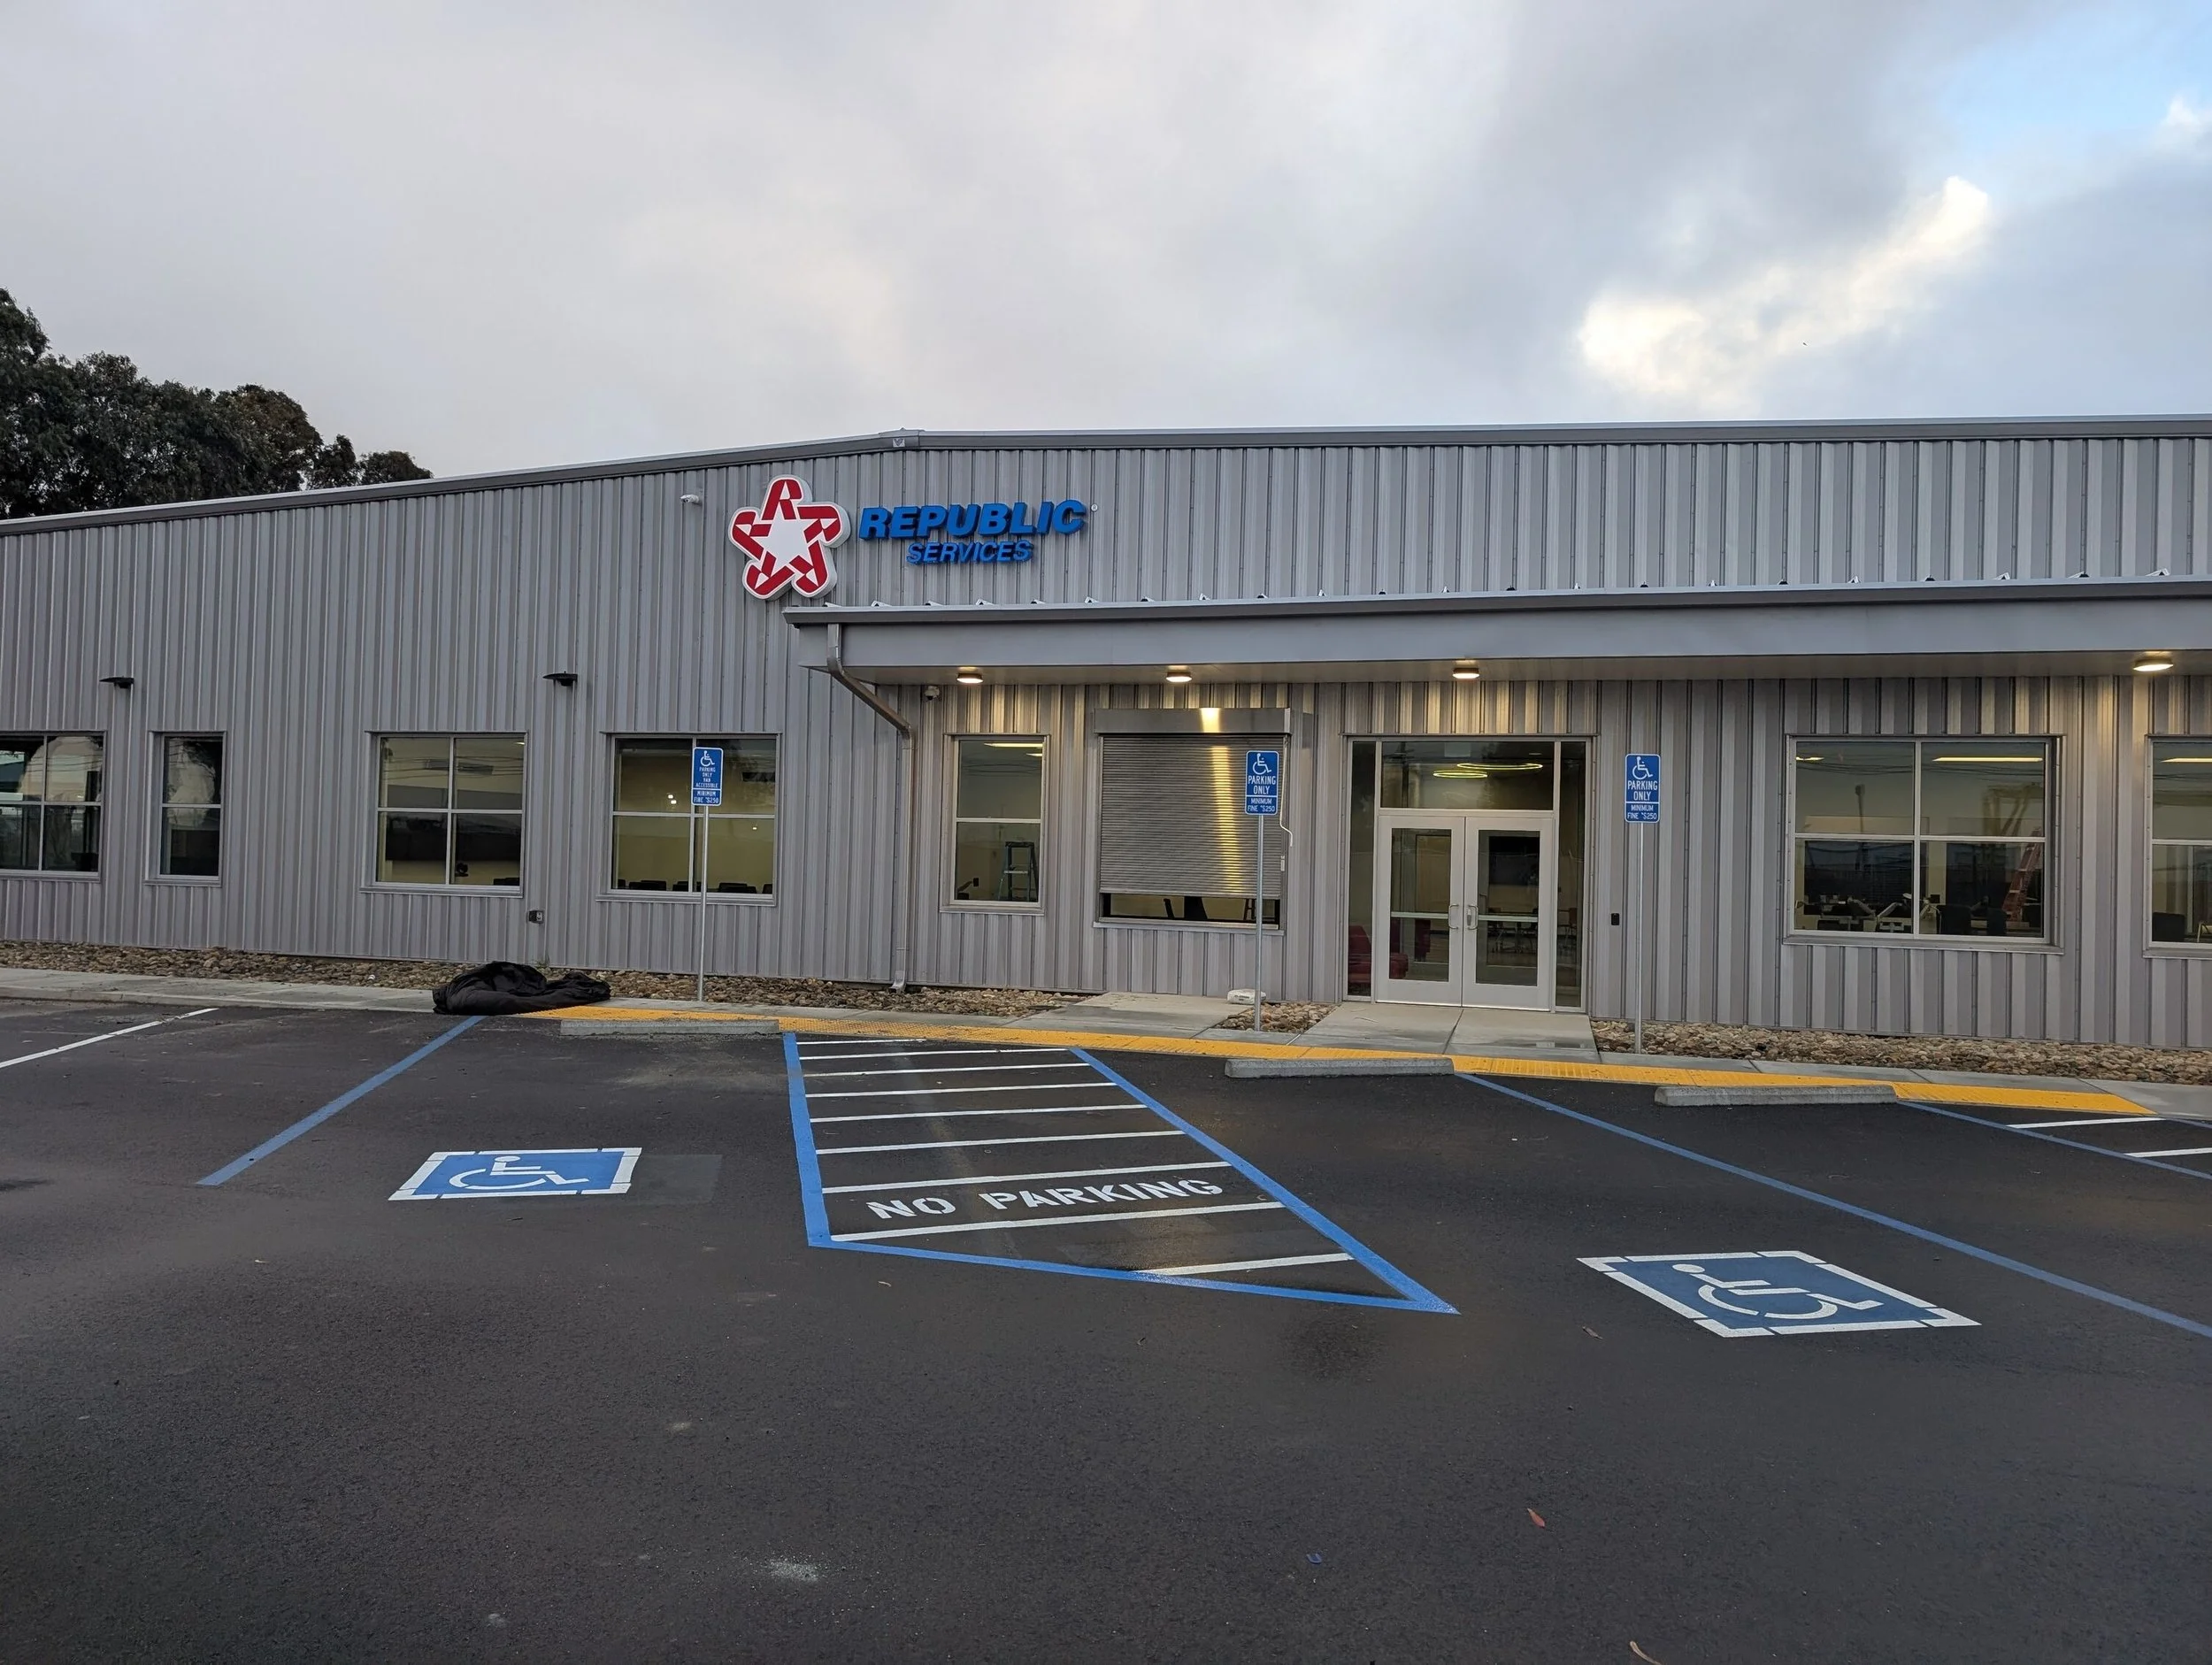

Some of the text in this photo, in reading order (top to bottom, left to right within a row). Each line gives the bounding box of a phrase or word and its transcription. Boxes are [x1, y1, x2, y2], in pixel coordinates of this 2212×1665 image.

[858, 500, 1087, 540] REPUBLIC
[905, 541, 1033, 564] SERVICES
[1248, 775, 1277, 786] PARKING
[1627, 780, 1658, 791] PARKING
[1253, 785, 1271, 794] ONLY
[1633, 790, 1652, 801] ONLY
[866, 1179, 1223, 1219] NO PARKING
